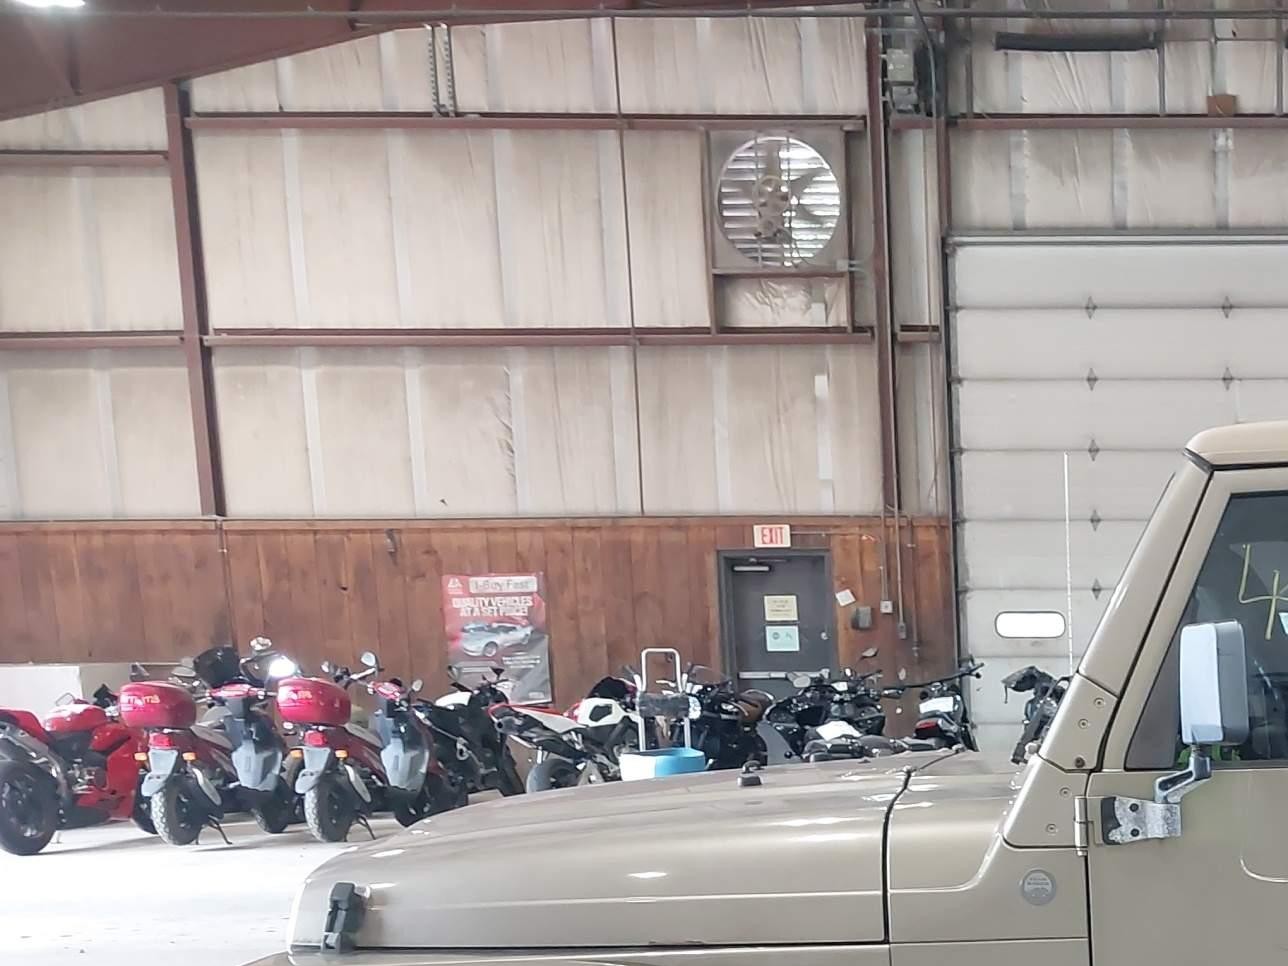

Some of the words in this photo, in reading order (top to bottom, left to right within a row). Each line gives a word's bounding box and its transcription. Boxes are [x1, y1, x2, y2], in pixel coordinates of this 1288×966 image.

[761, 527, 784, 545] EXIT
[452, 597, 490, 608] QUALITY
[460, 606, 473, 616] AT
[480, 606, 498, 616] SET
